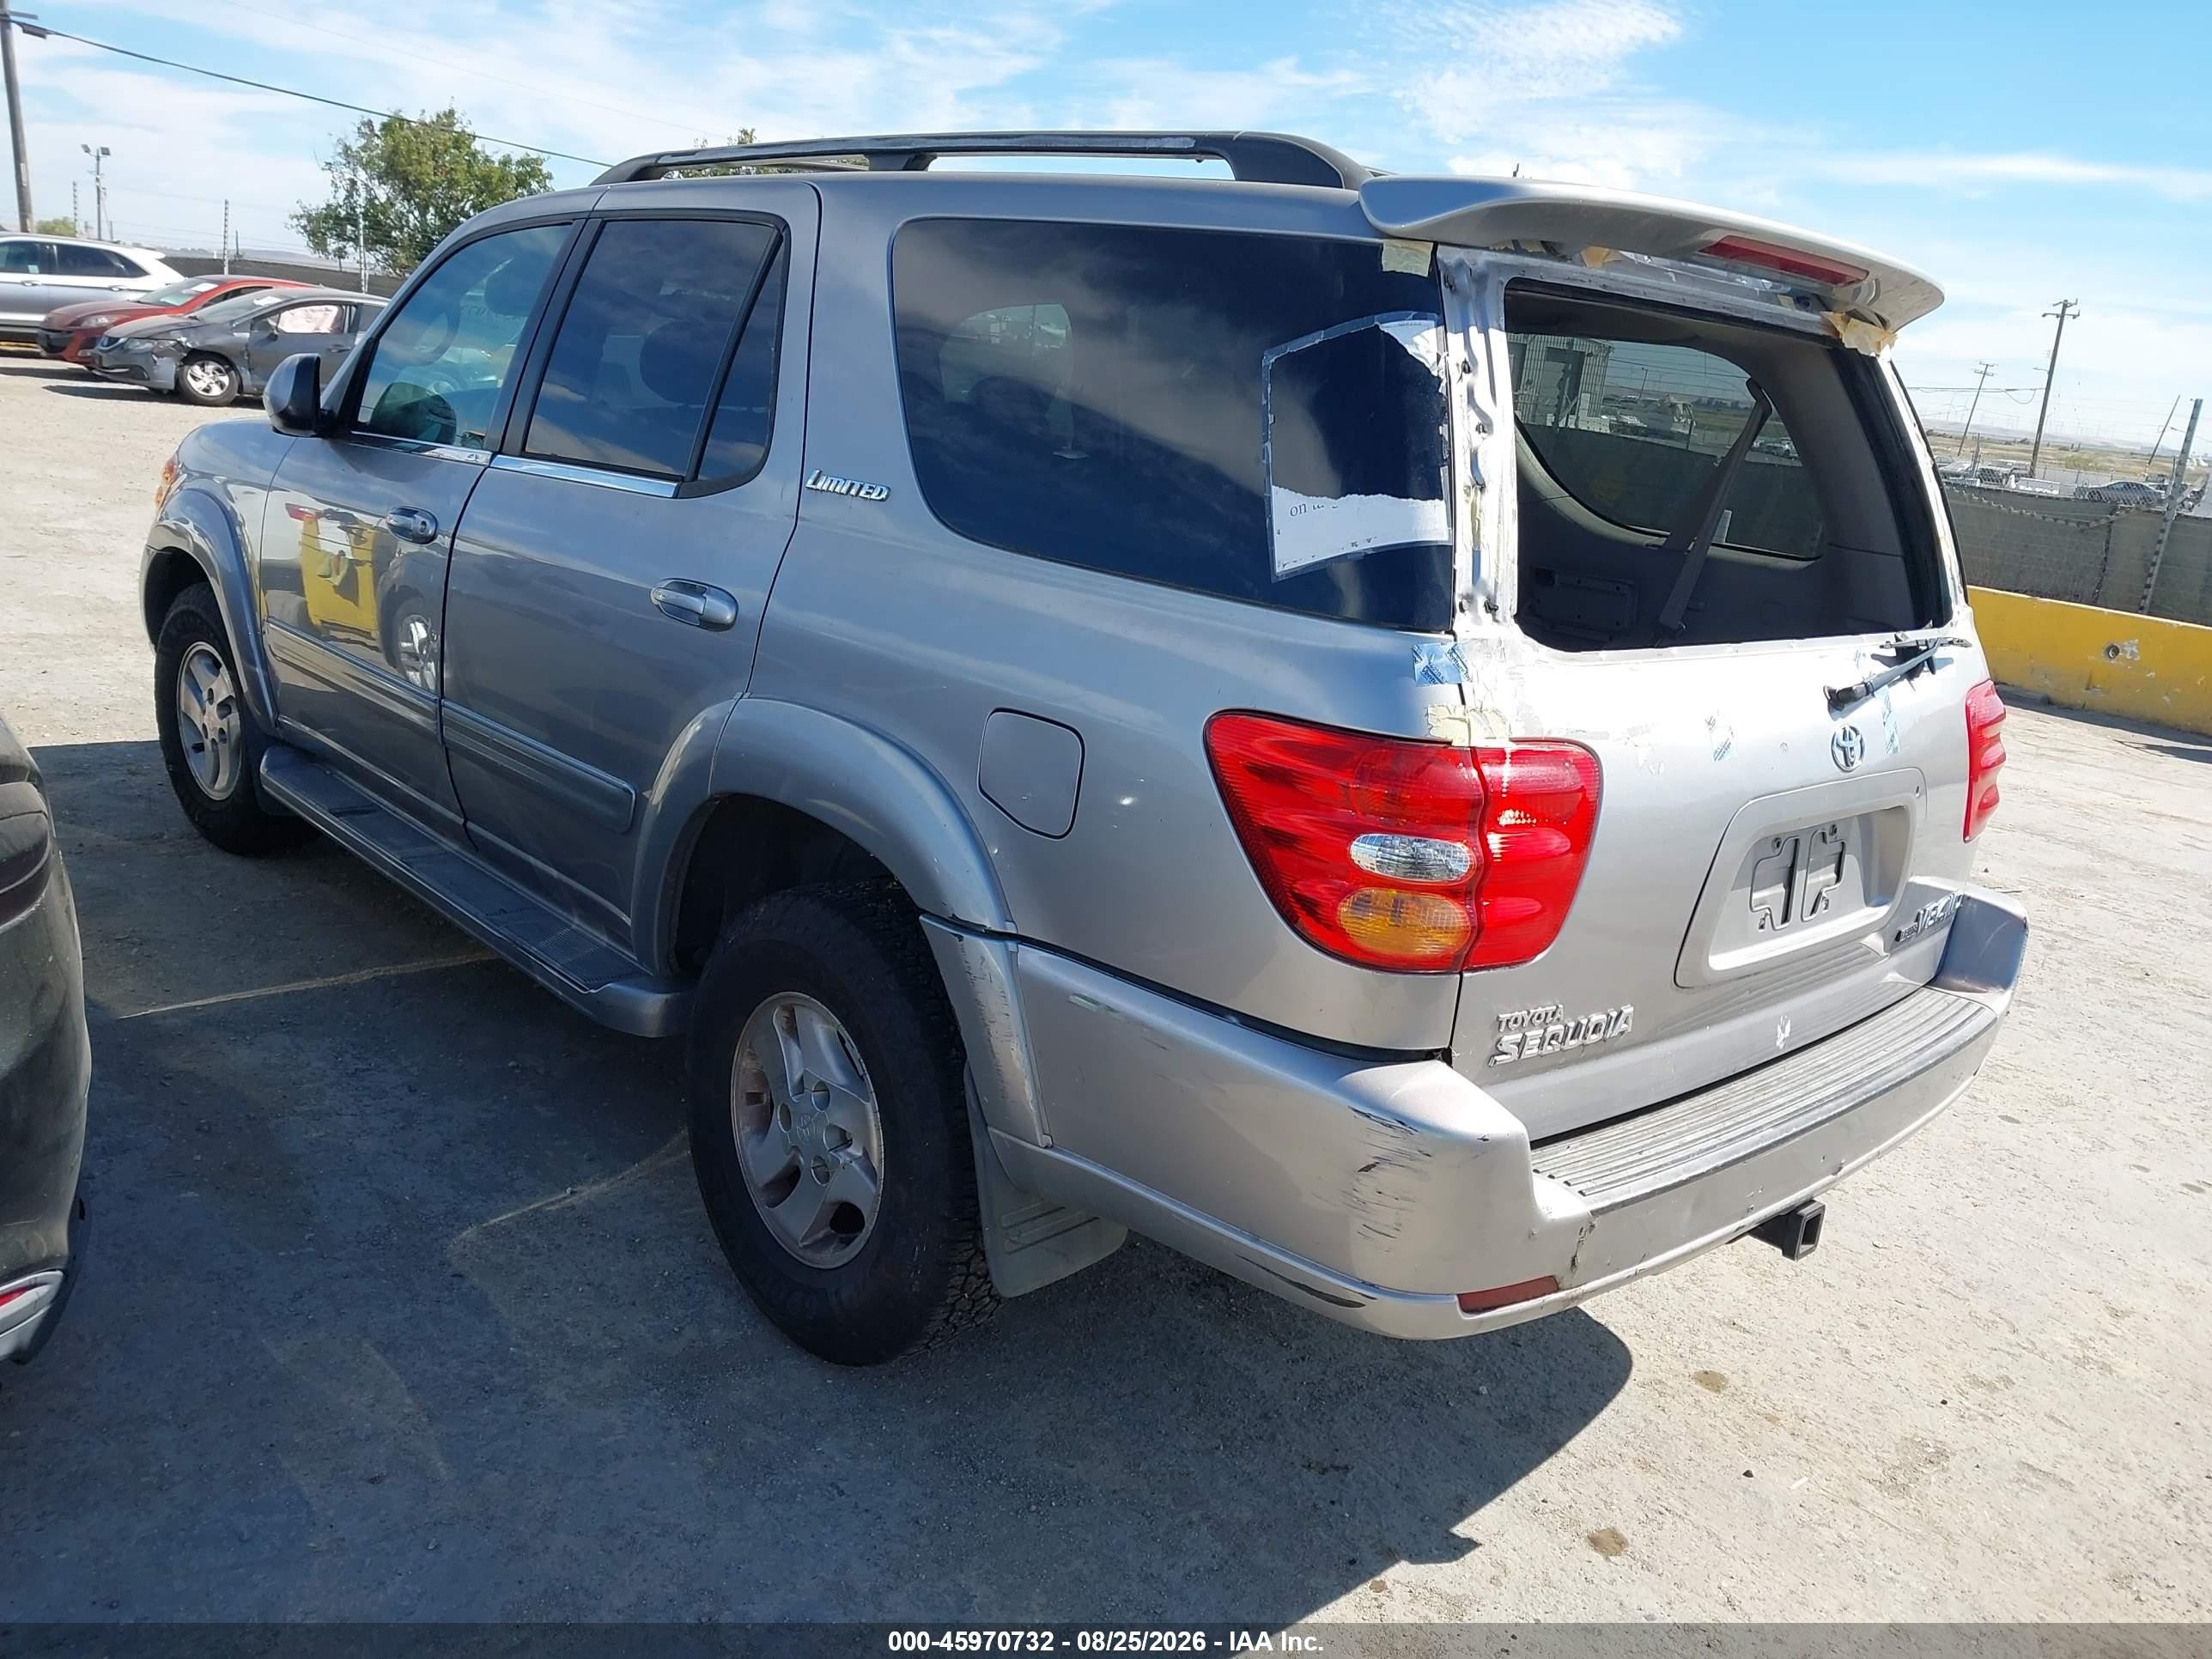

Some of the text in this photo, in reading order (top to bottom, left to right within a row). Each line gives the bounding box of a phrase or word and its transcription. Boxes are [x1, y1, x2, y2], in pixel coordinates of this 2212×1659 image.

[805, 469, 890, 501] LIMITED
[1290, 501, 1307, 516] on
[1497, 1004, 1565, 1032] TOYOTA
[1489, 1004, 1634, 1067] SEQUOIA
